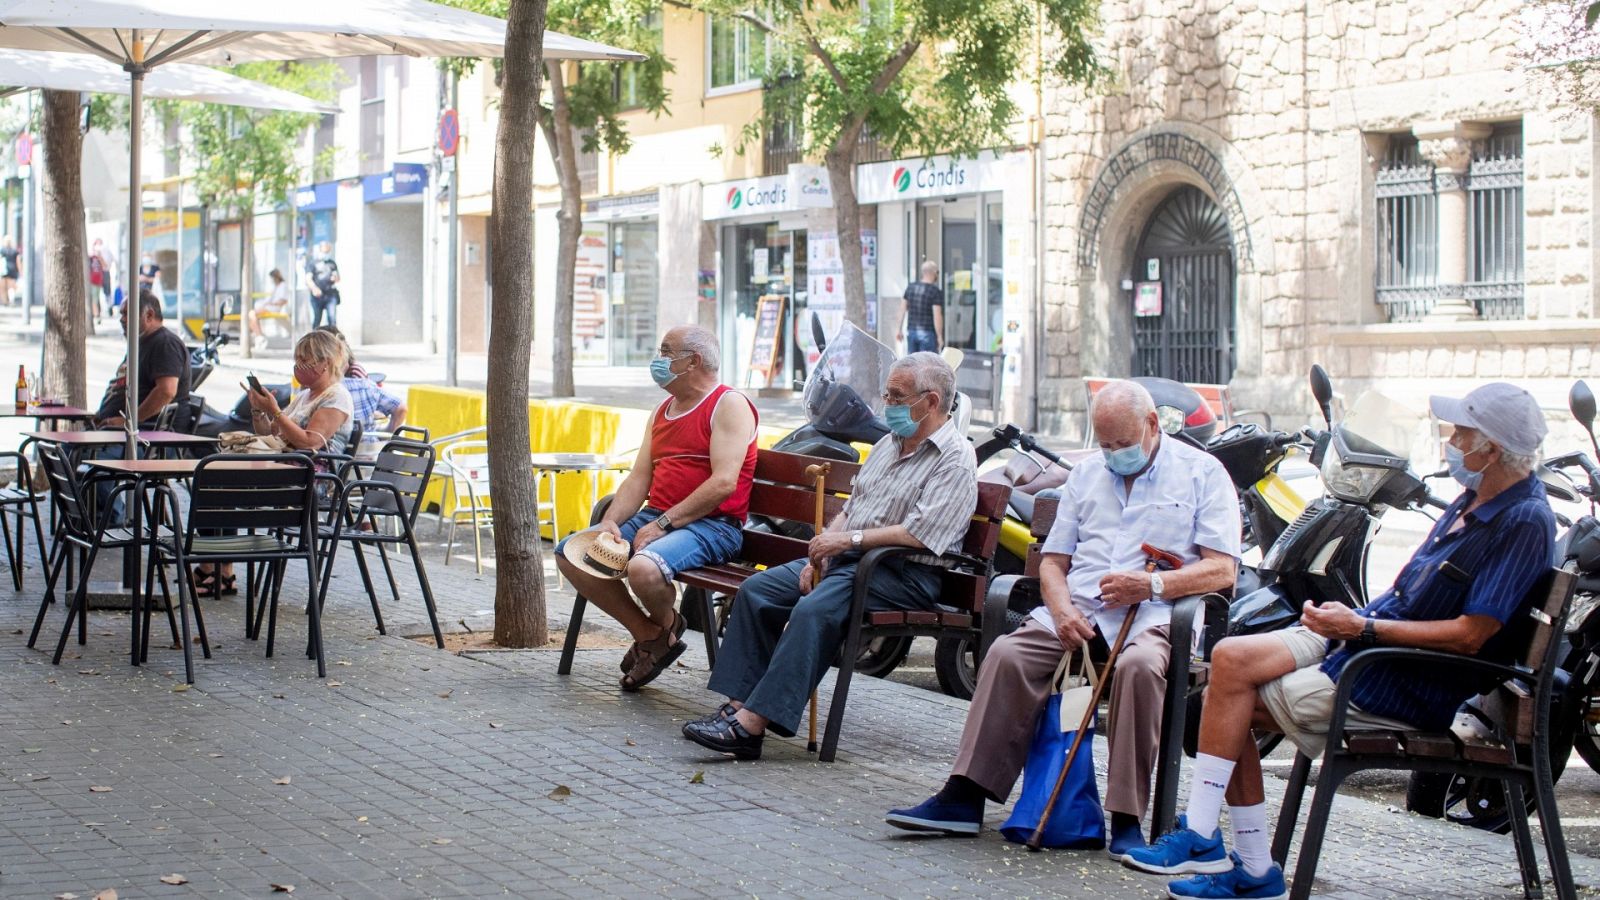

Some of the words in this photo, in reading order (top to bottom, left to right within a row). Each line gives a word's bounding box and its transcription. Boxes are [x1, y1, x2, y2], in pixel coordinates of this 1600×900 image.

[916, 166, 966, 189] Condis
[746, 183, 787, 207] Condis
[801, 184, 829, 196] Condis
[1203, 781, 1225, 789] FILA
